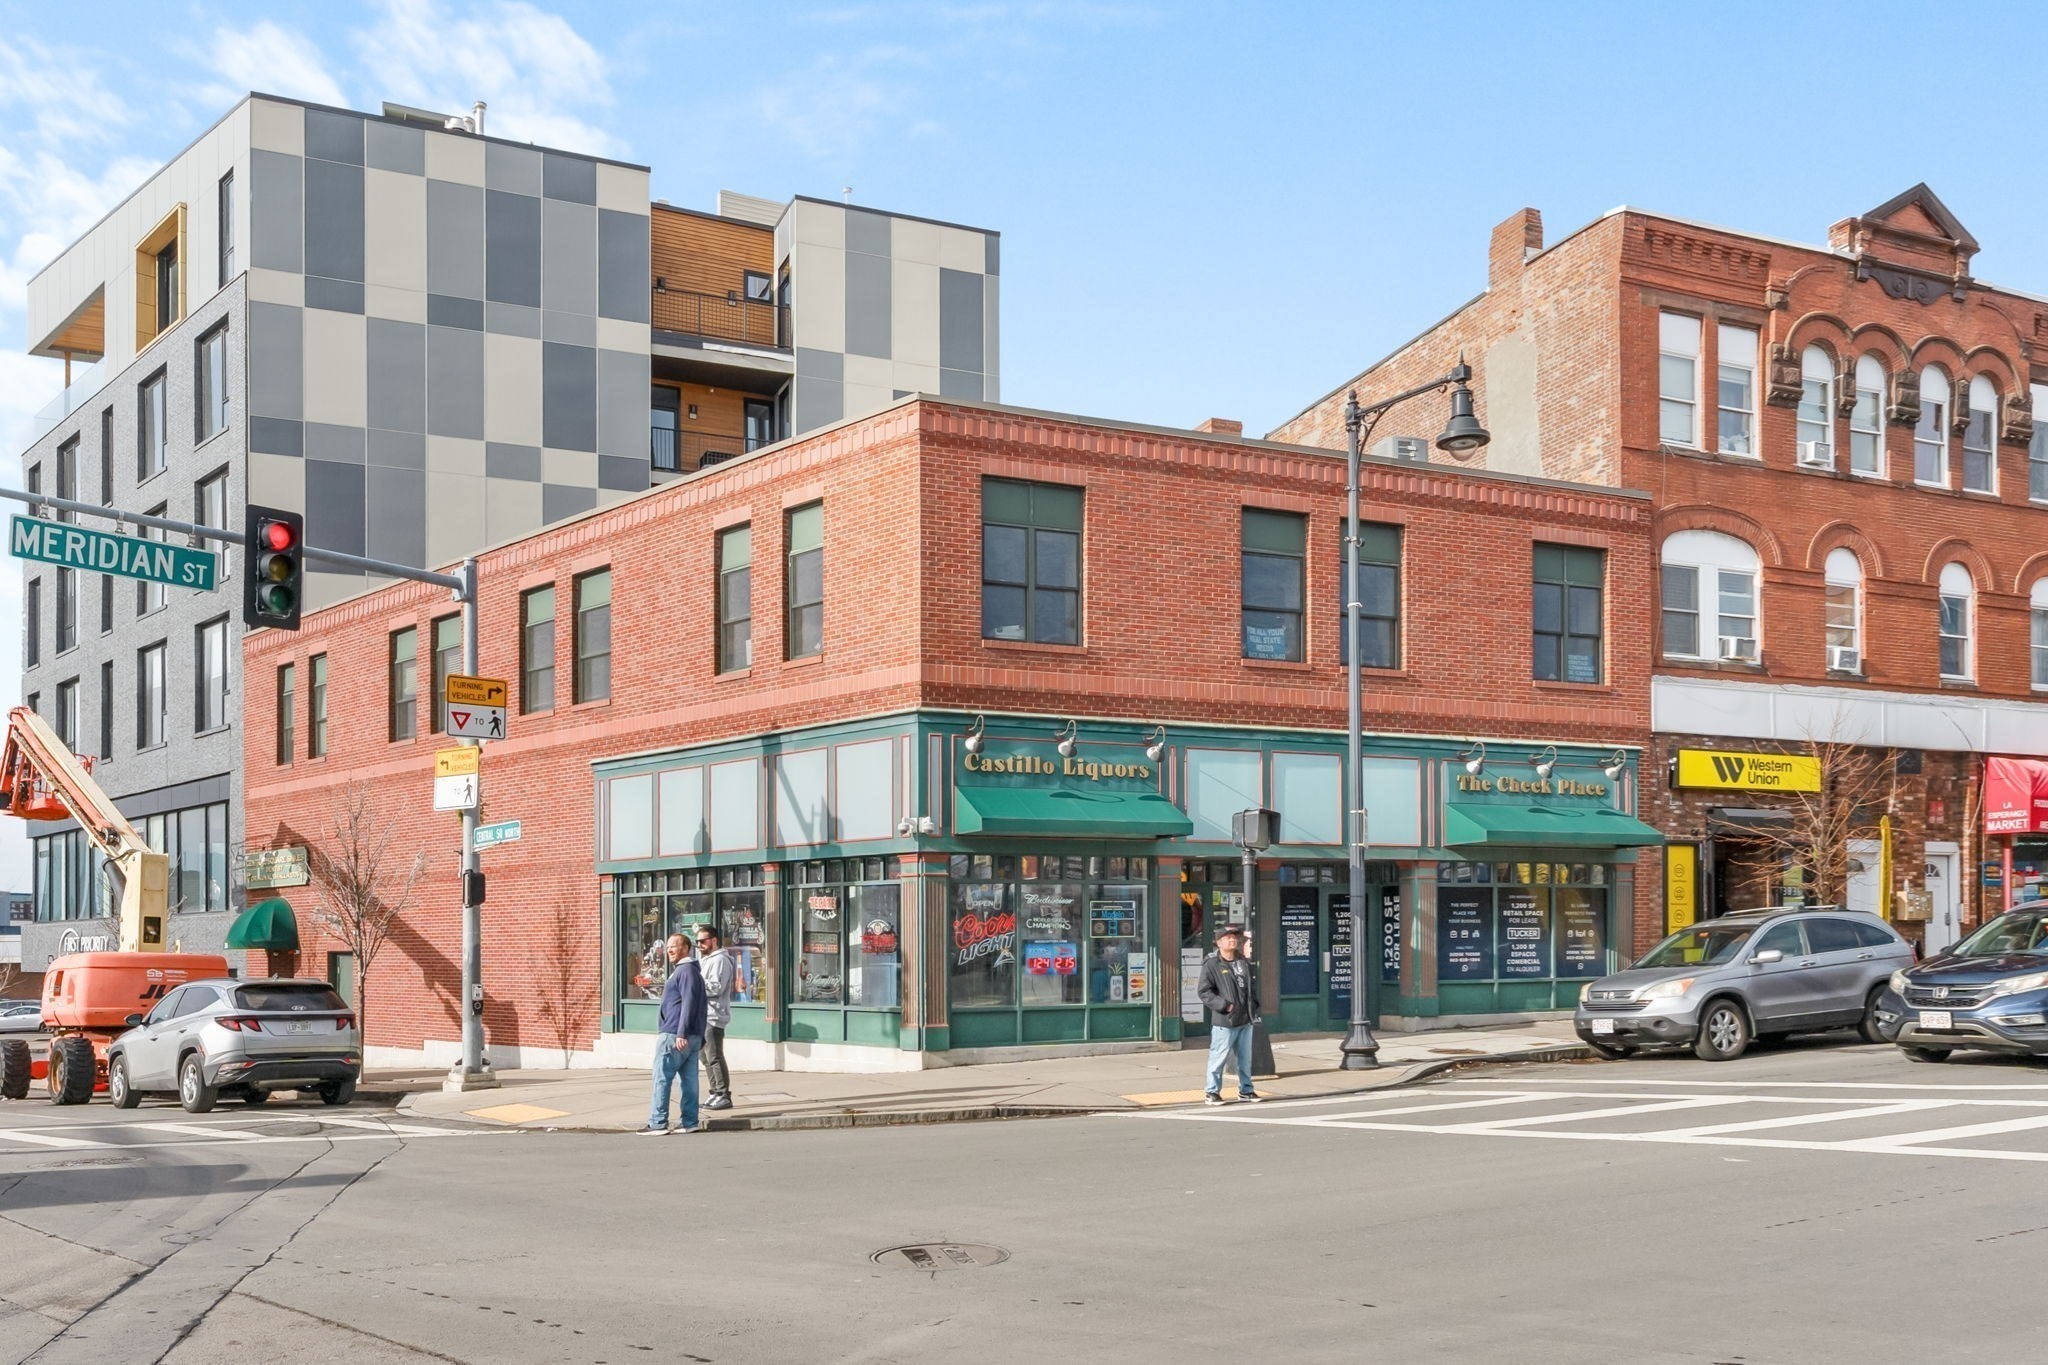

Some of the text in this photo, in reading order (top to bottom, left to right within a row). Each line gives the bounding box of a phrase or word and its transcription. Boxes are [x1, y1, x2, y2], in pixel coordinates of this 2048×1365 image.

[15, 521, 208, 585] MERIDIAN ST
[1263, 636, 1281, 644] STATE
[452, 681, 484, 690] TURNING
[451, 692, 487, 702] VEHICLES
[475, 717, 485, 726] TO
[964, 753, 1150, 781] Castillo Liquors
[1748, 758, 1793, 773] Western
[1748, 772, 1780, 785] Union
[1457, 774, 1606, 797] The Check Place
[1987, 810, 2027, 819] ESPERANZA
[1986, 819, 2029, 831] MARKET
[1024, 893, 1074, 905] Budweiser
[1383, 896, 1393, 918] SF
[1026, 919, 1071, 930] CHAMPIONS
[64, 935, 109, 952] FIRST PRIORITY
[958, 931, 1015, 965] LIGHT
[139, 984, 181, 999] JL
